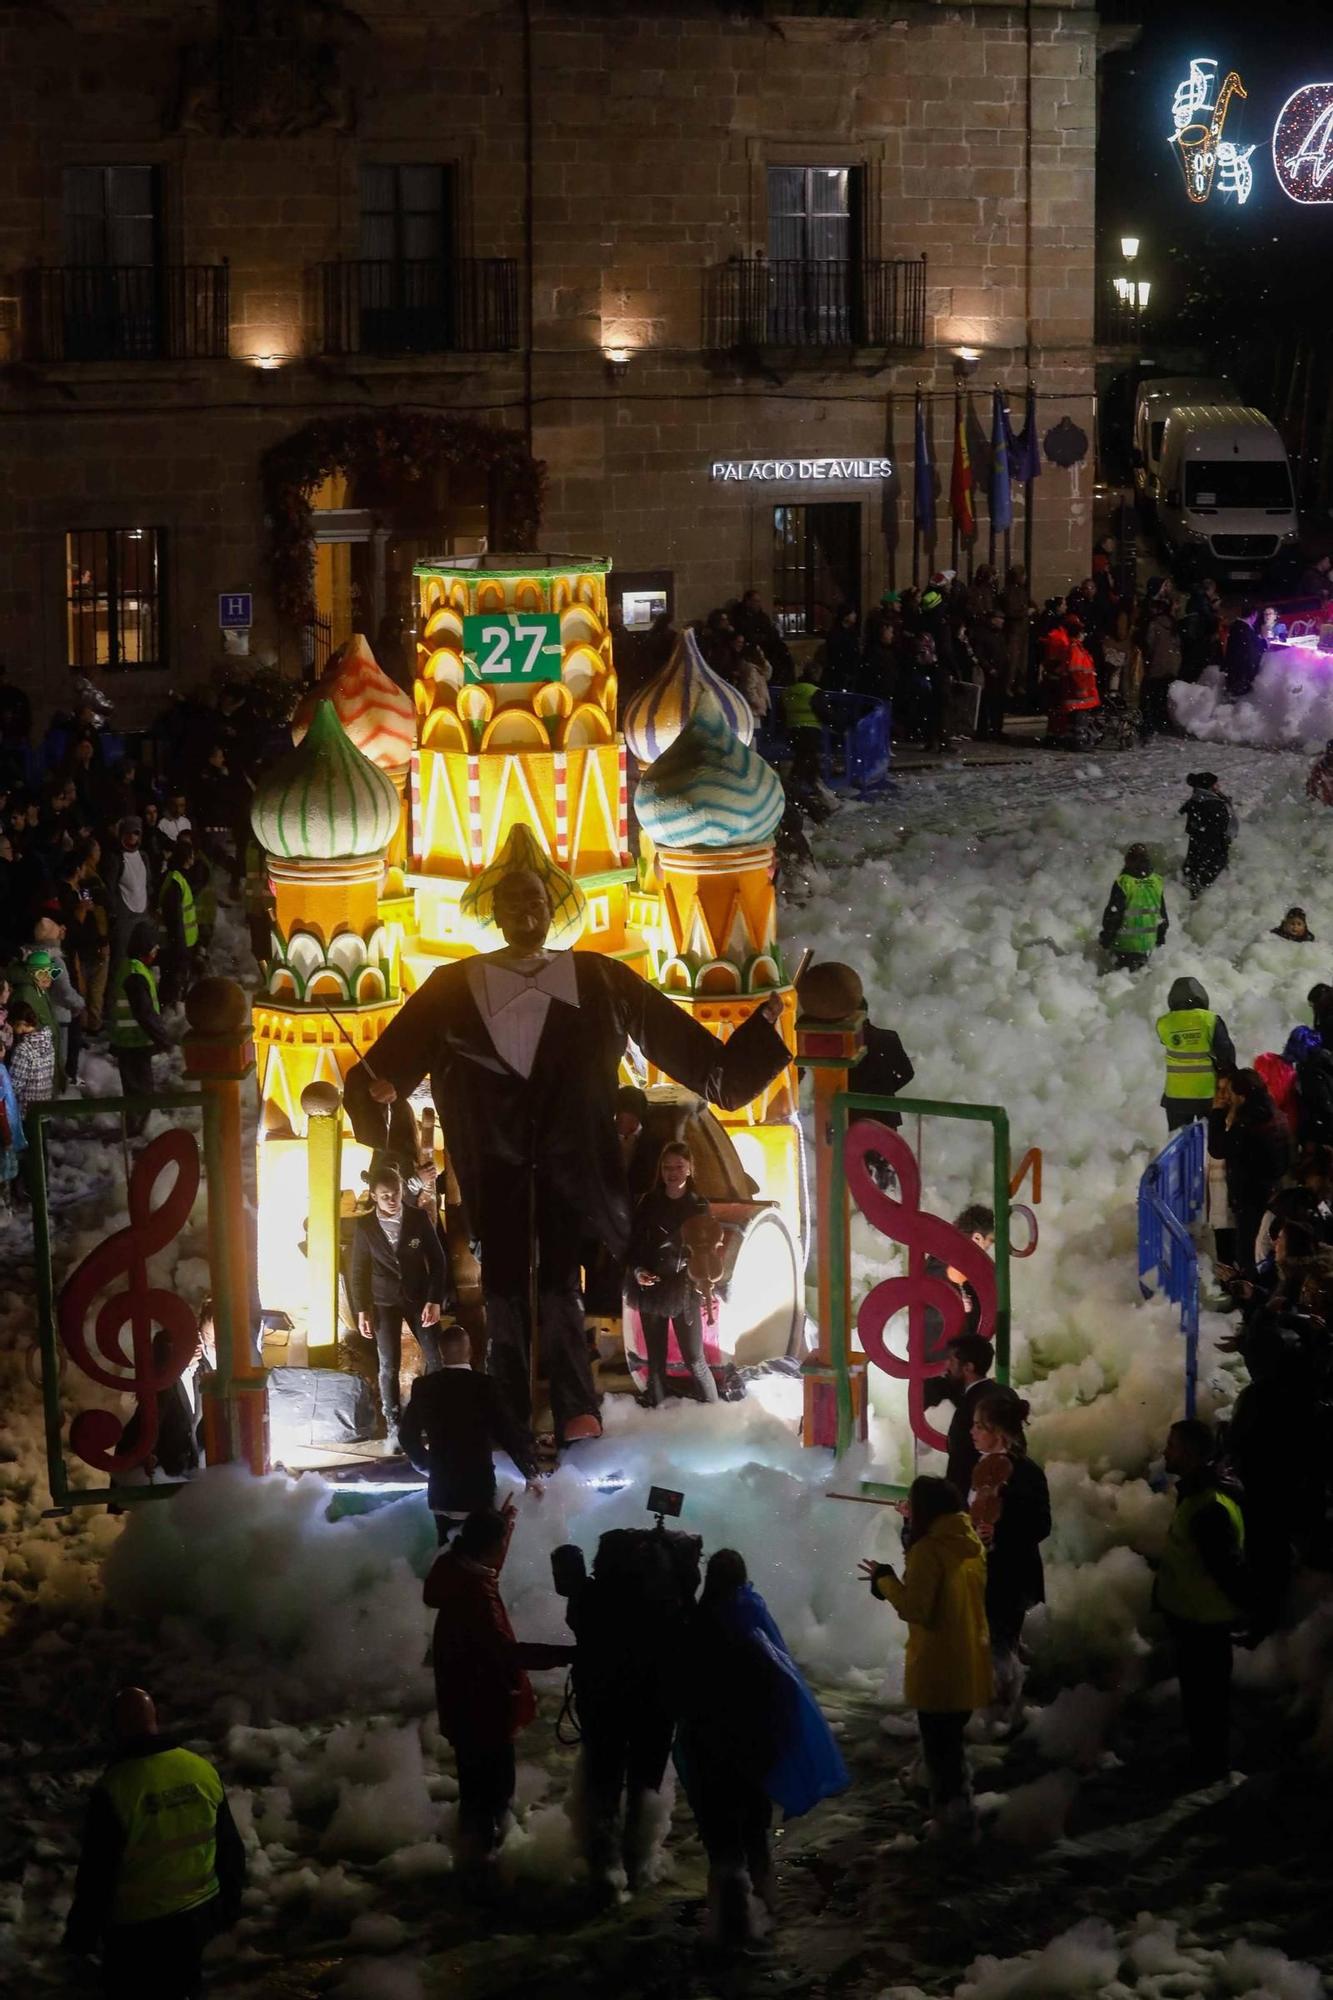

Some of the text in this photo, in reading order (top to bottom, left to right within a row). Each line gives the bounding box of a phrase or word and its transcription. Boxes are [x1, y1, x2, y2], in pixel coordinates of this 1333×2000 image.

[712, 462, 794, 481] PALACIO
[799, 462, 826, 479] DE
[227, 598, 244, 616] H
[480, 626, 548, 674] 27
